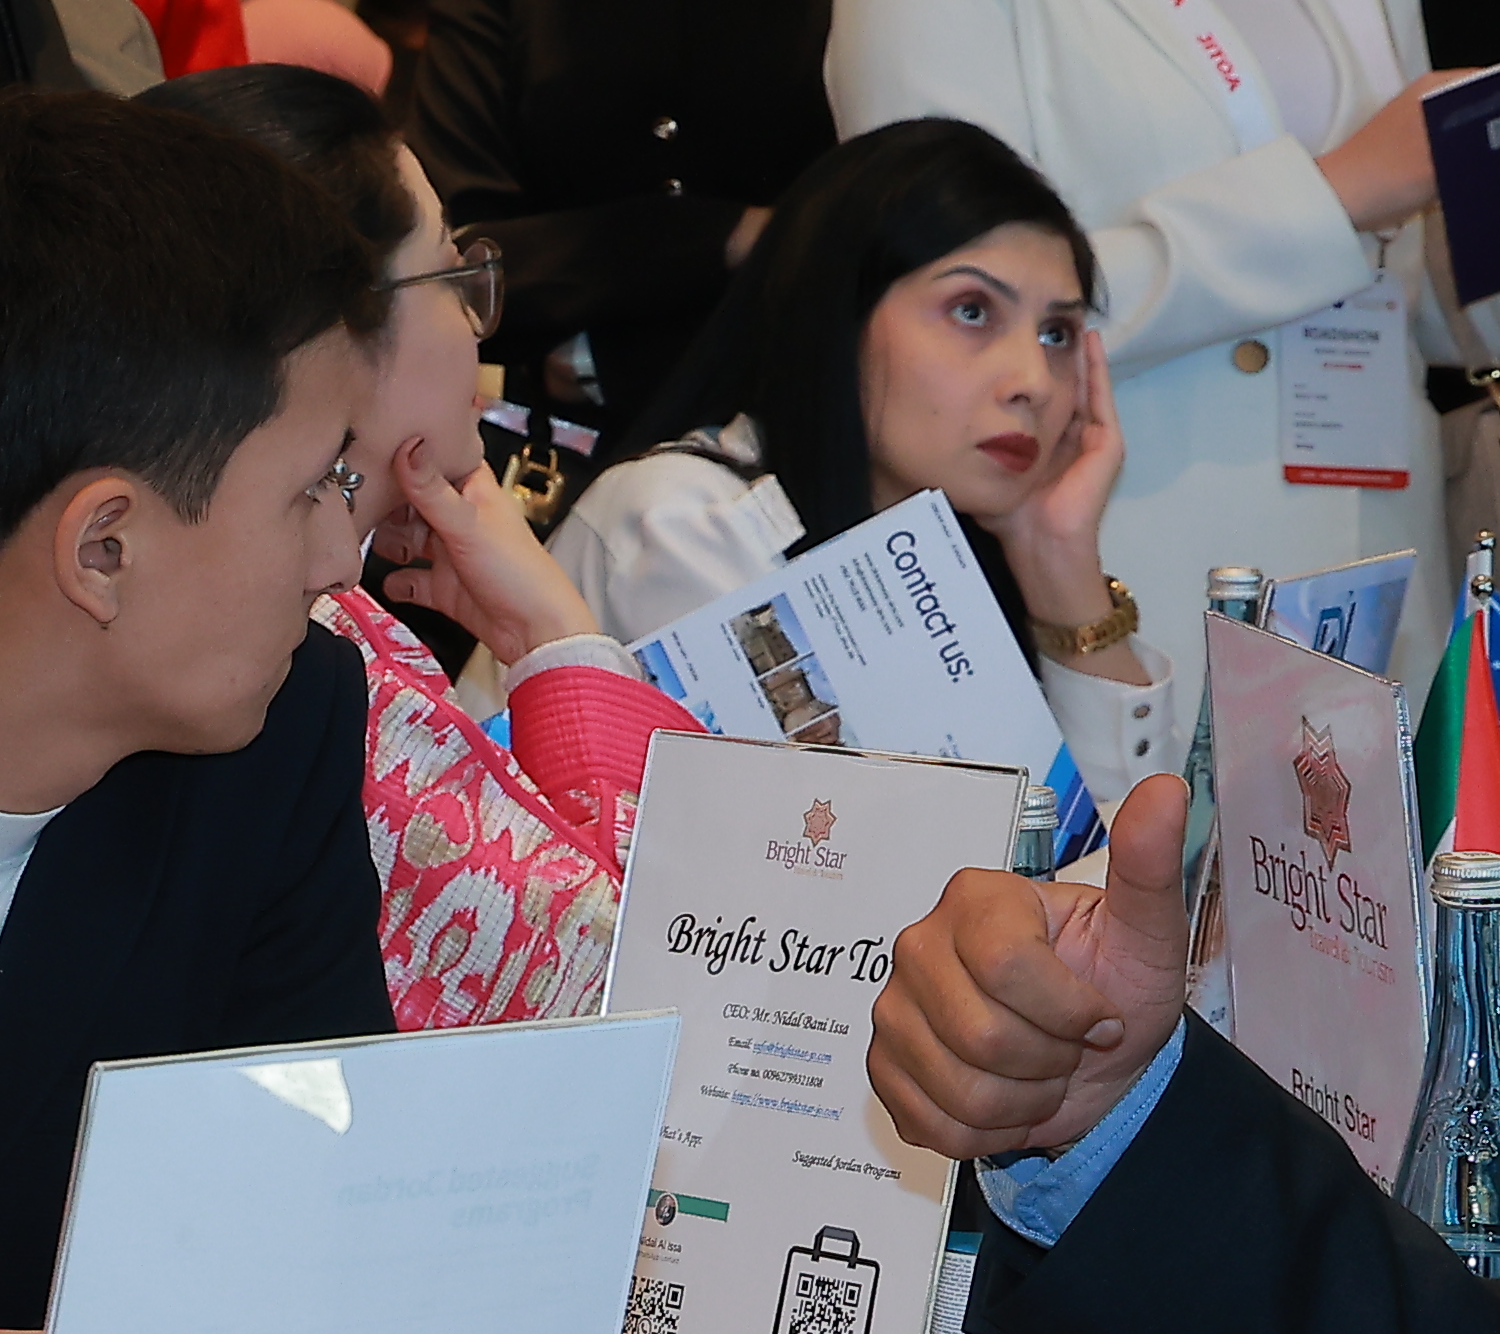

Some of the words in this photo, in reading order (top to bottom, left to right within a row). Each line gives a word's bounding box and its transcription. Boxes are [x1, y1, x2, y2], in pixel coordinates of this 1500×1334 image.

[886, 530, 957, 639] Contact
[939, 640, 975, 684] us:
[766, 840, 811, 870] Bright
[814, 846, 847, 870] Star
[1249, 835, 1332, 932] Bright
[1337, 873, 1389, 951] Star
[667, 913, 767, 976] Bright
[769, 928, 846, 976] Star
[849, 936, 894, 984] To
[722, 1003, 750, 1019] CEO:
[752, 1007, 770, 1023] Mr.
[771, 1011, 804, 1028] Nidal
[802, 1016, 828, 1031] Bani
[827, 1019, 851, 1035] Issa
[1291, 1067, 1341, 1125] Bright
[1344, 1094, 1376, 1143] Star
[659, 1125, 682, 1142] hat's
[792, 1150, 834, 1172] Suggested
[833, 1155, 863, 1174] Jordan
[862, 1162, 902, 1181] Programs
